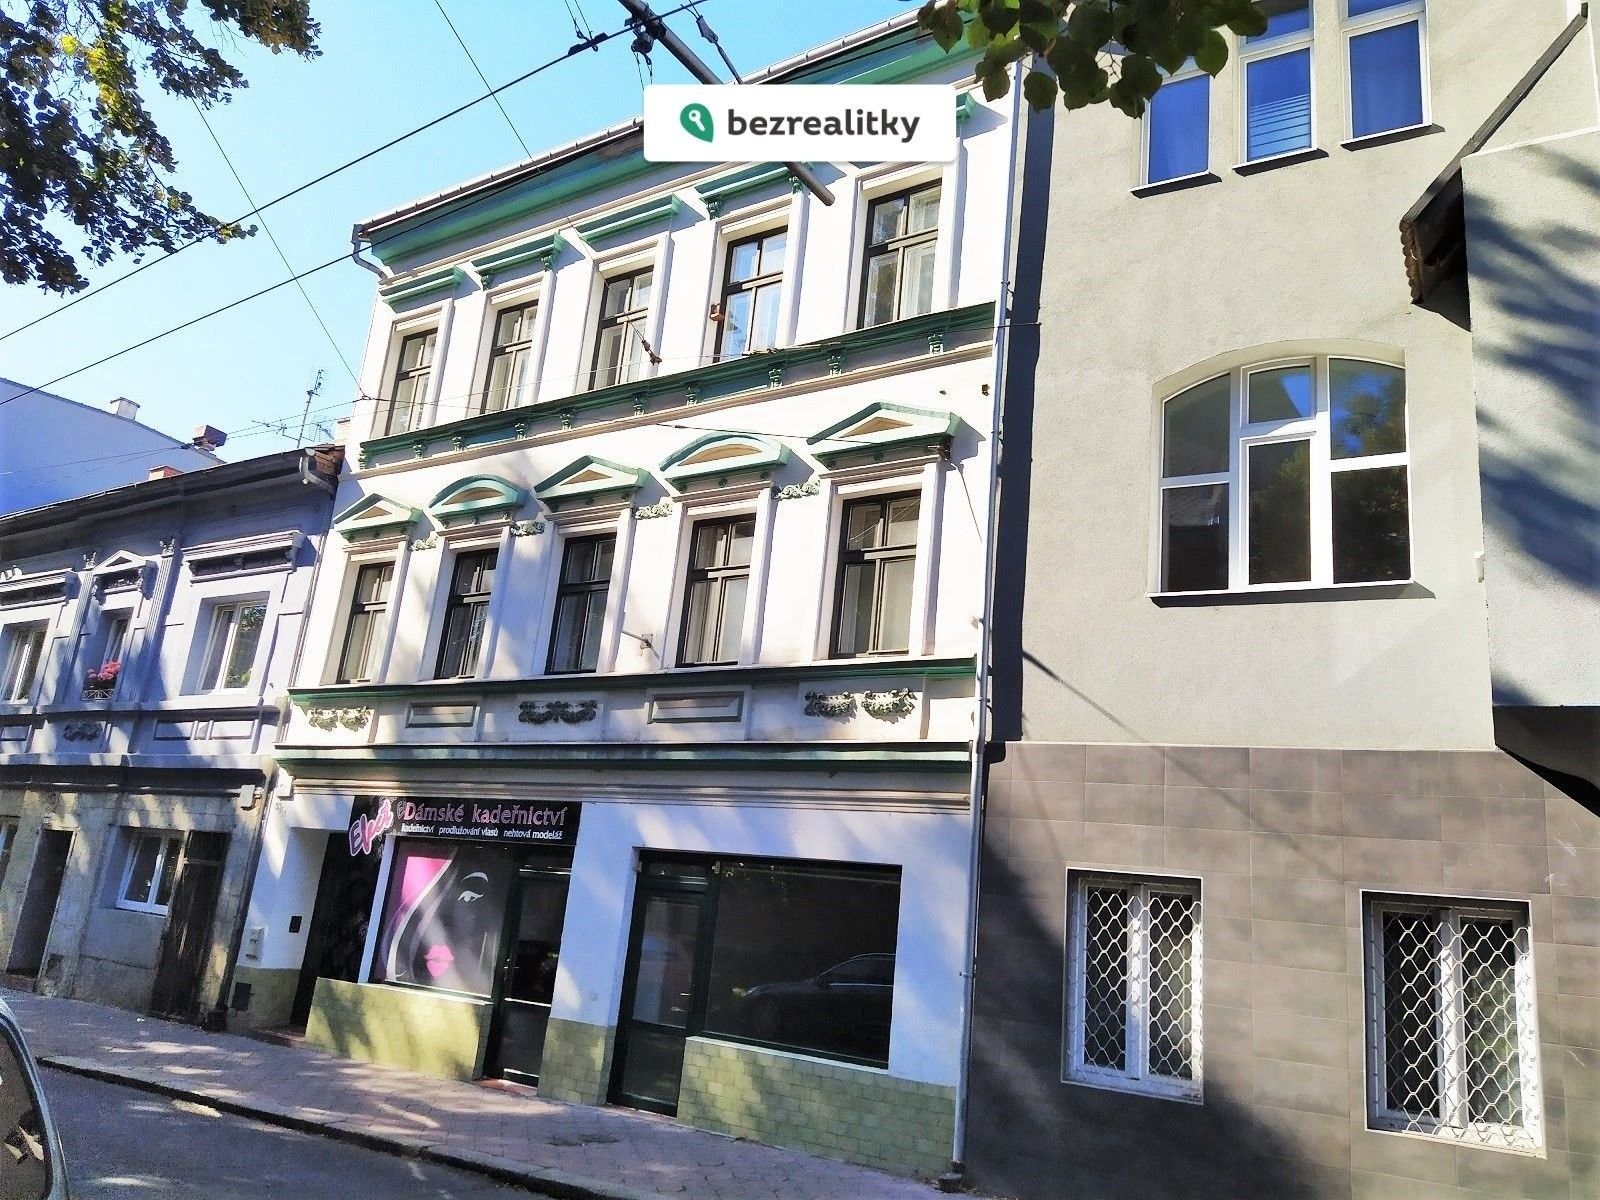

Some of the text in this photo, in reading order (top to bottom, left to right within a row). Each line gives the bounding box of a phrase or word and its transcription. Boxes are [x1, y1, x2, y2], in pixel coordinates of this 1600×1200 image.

[403, 801, 568, 826] Dámské kadeřnictví
[438, 825, 481, 836] prodlužování
[503, 828, 532, 839] nehtová
[532, 829, 563, 840] modeláž
